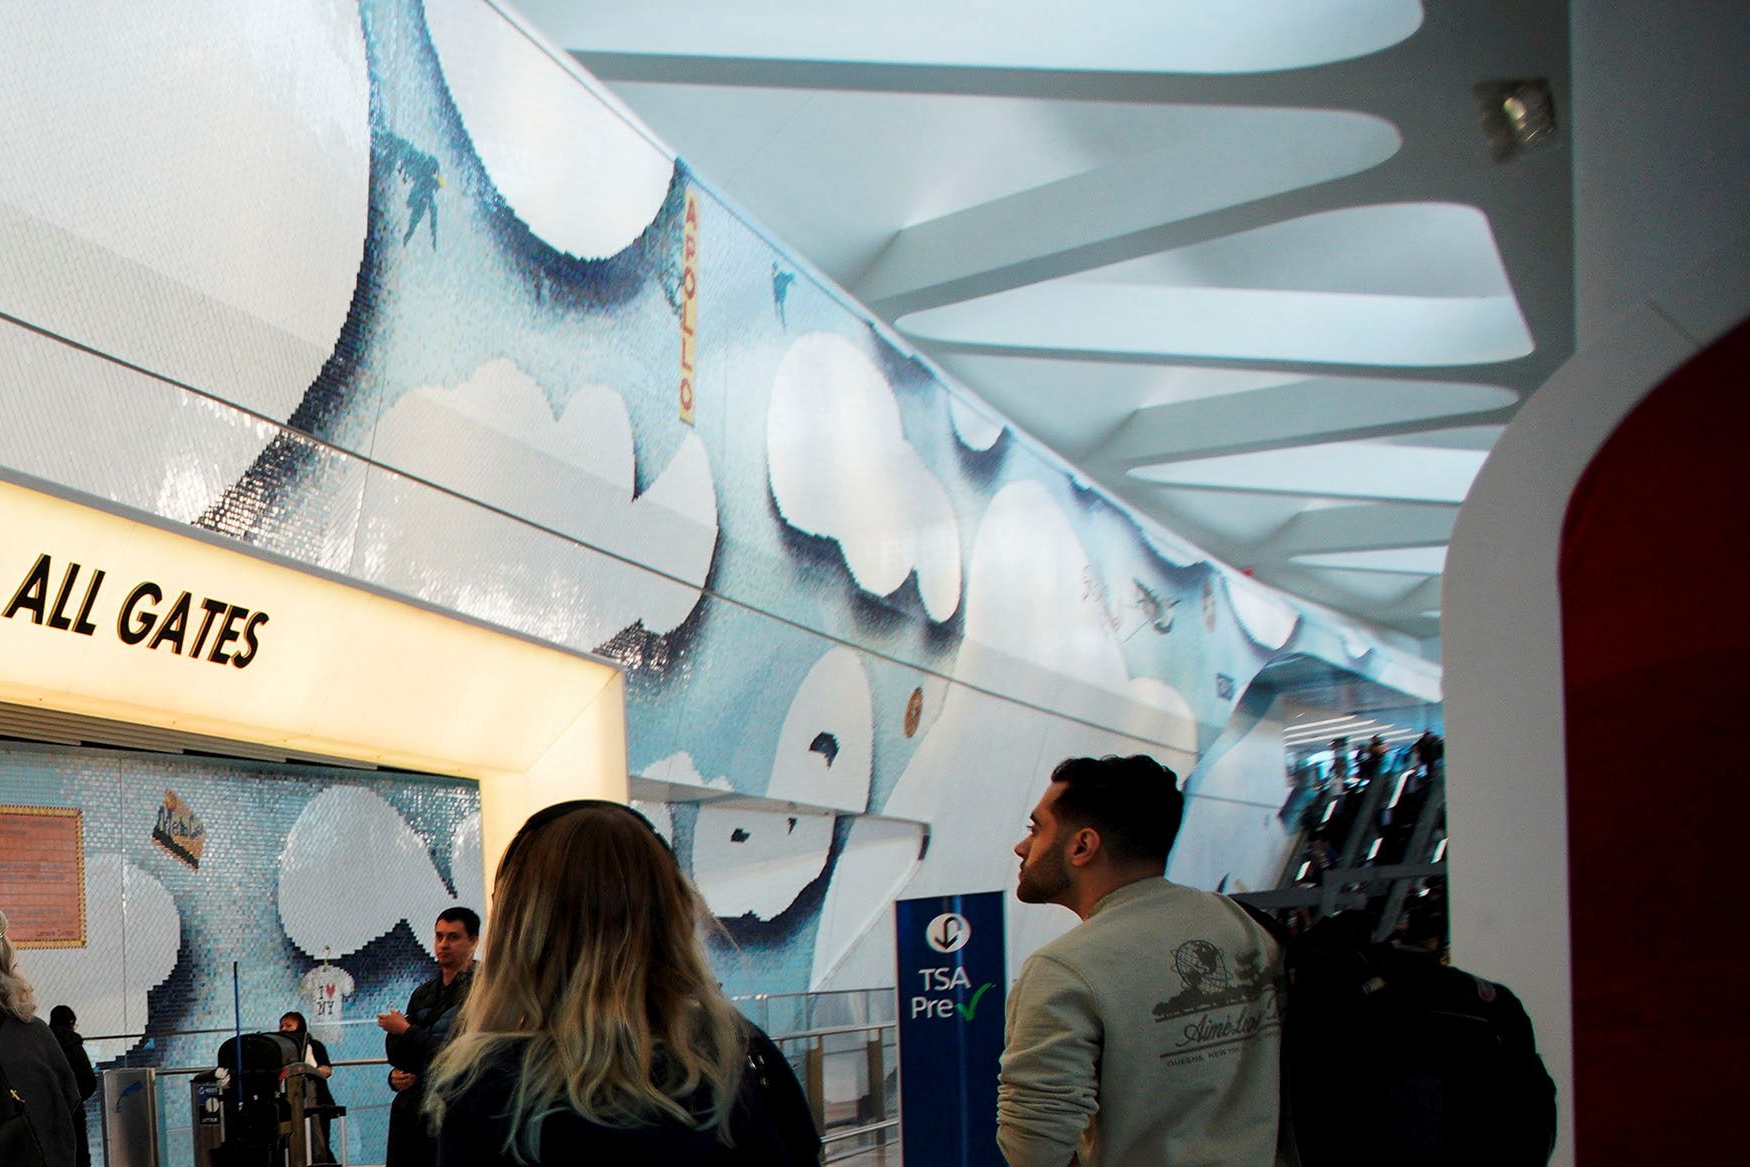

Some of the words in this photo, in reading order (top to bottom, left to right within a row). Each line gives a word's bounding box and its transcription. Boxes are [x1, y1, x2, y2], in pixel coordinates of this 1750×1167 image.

[680, 199, 697, 411] APOLLO
[0, 553, 106, 637] ALL
[116, 580, 270, 669] GATES
[911, 996, 954, 1019] Pre
[918, 966, 971, 992] TSA
